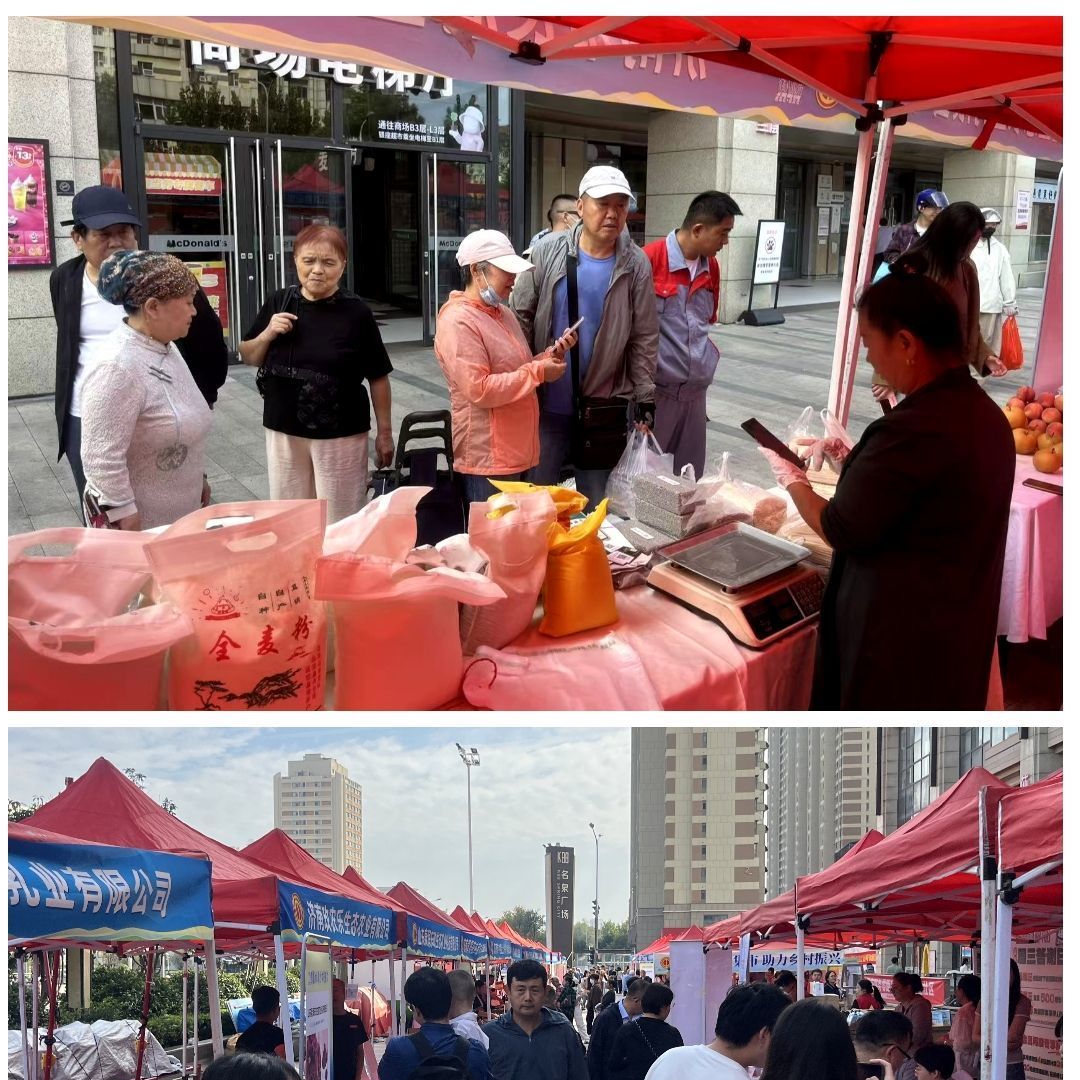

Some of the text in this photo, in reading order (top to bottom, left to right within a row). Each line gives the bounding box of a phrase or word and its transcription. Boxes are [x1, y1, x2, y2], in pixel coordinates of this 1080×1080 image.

[208, 615, 313, 661] 全麦粉
[561, 869, 569, 920] 名泉广场
[762, 952, 841, 966] 助力乡村振兴
